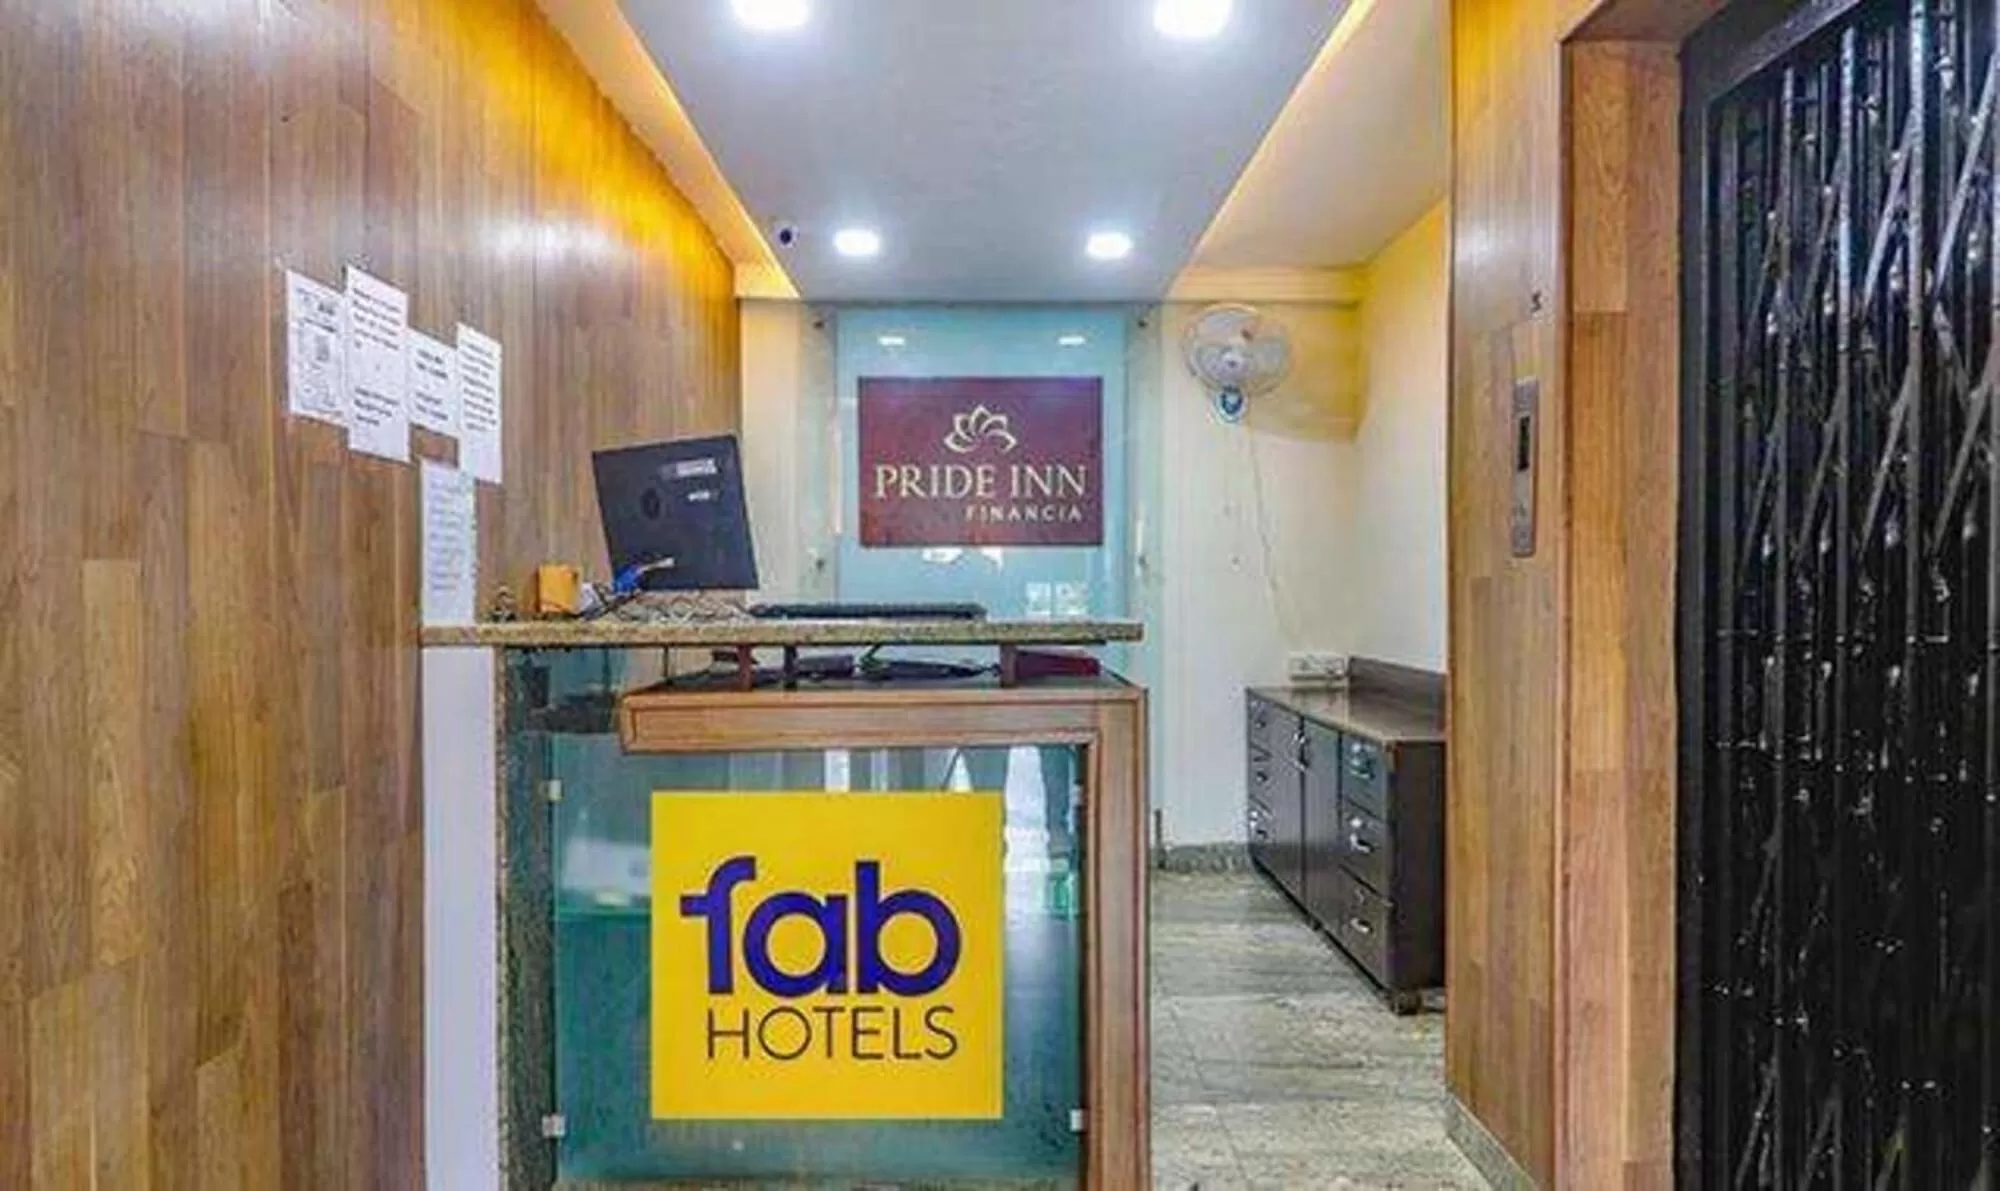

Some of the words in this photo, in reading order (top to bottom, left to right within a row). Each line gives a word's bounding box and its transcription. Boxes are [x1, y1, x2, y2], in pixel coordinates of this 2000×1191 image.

[874, 463, 997, 499] PRIDE
[1010, 463, 1086, 499] INN
[965, 504, 1083, 522] FINANCIA
[680, 856, 962, 999] fab
[707, 1005, 958, 1061] HOTELS
